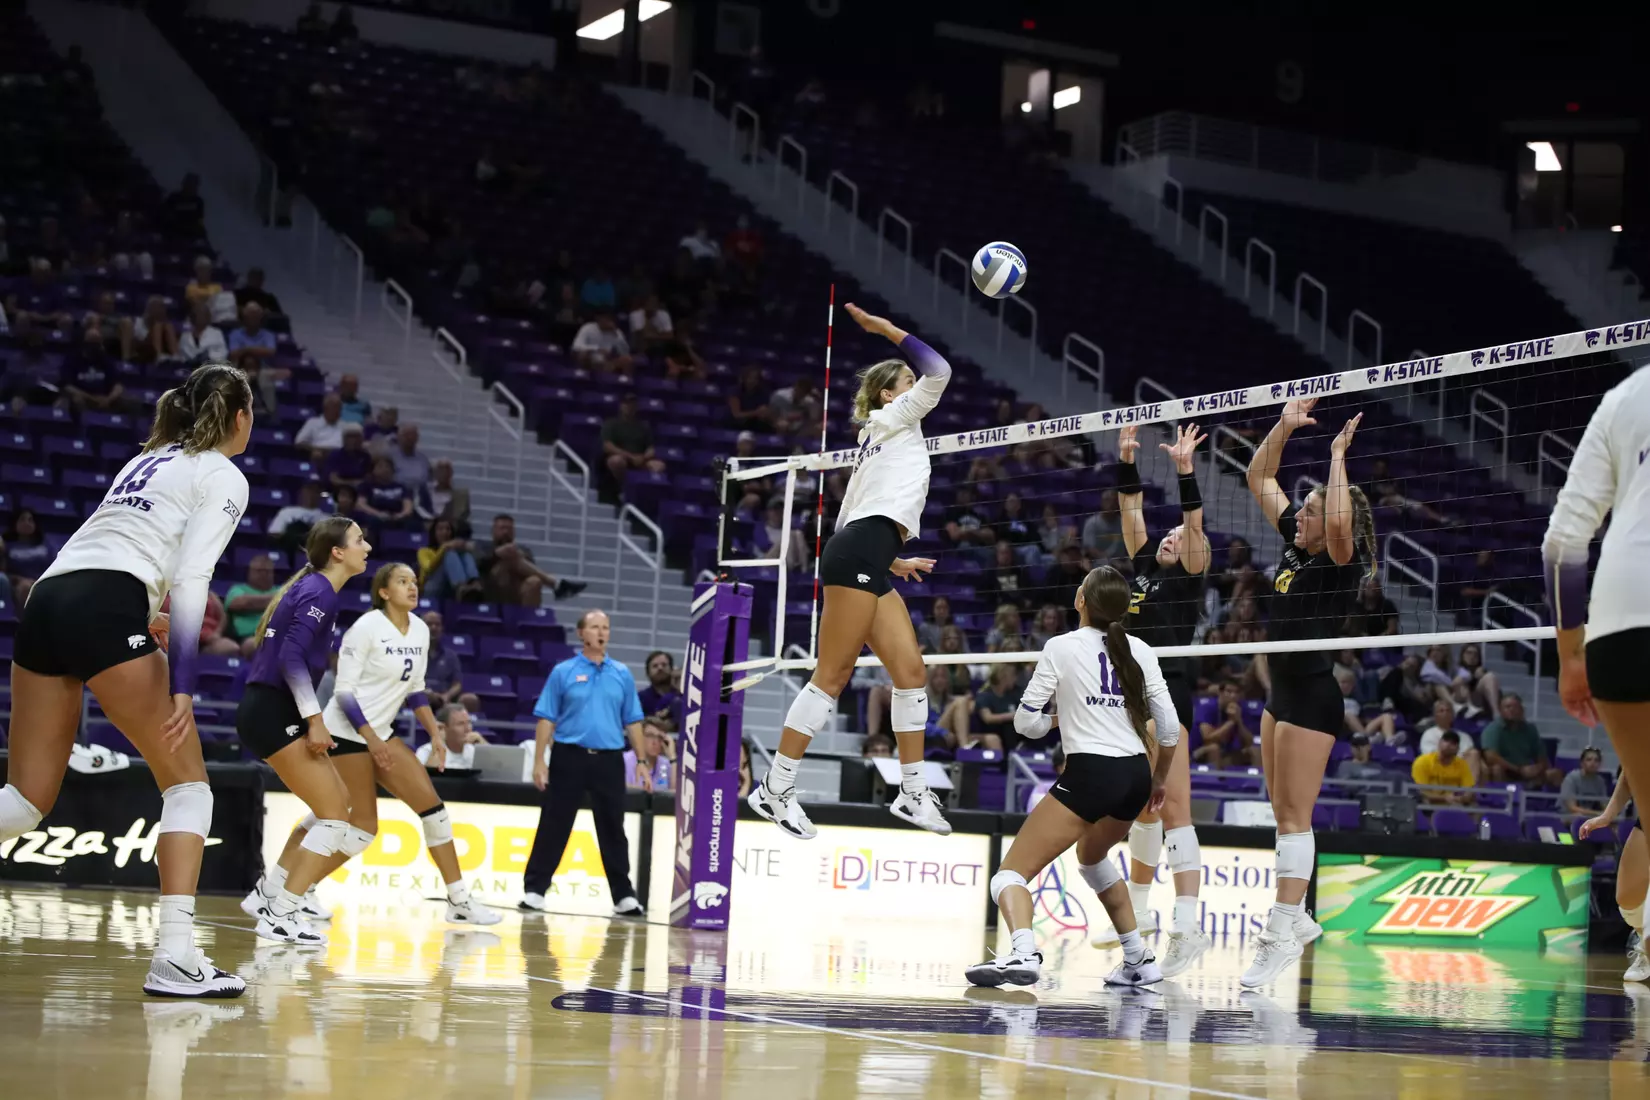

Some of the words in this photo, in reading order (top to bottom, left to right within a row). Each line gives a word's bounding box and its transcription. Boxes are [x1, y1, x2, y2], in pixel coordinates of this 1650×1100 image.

[1274, 59, 1304, 104] 9
[995, 249, 1024, 268] molten
[969, 427, 1009, 446] K-STATE
[1039, 416, 1082, 436] K-STATE
[1115, 404, 1161, 424] K-STATE
[1197, 390, 1248, 411] K-STATE
[1286, 374, 1342, 397] K-STATE
[1383, 357, 1443, 382] K-STATE
[1489, 338, 1555, 365] K-STATE
[1605, 320, 1650, 345] K-STA
[112, 456, 176, 497] 15
[385, 646, 423, 656] K-STATE
[400, 658, 413, 682] 2
[677, 642, 706, 872] K-STATE
[712, 788, 723, 826] sports
[360, 873, 507, 893] MEXIAN
[547, 882, 601, 897] ATS
[841, 856, 983, 887] DISTRICT
